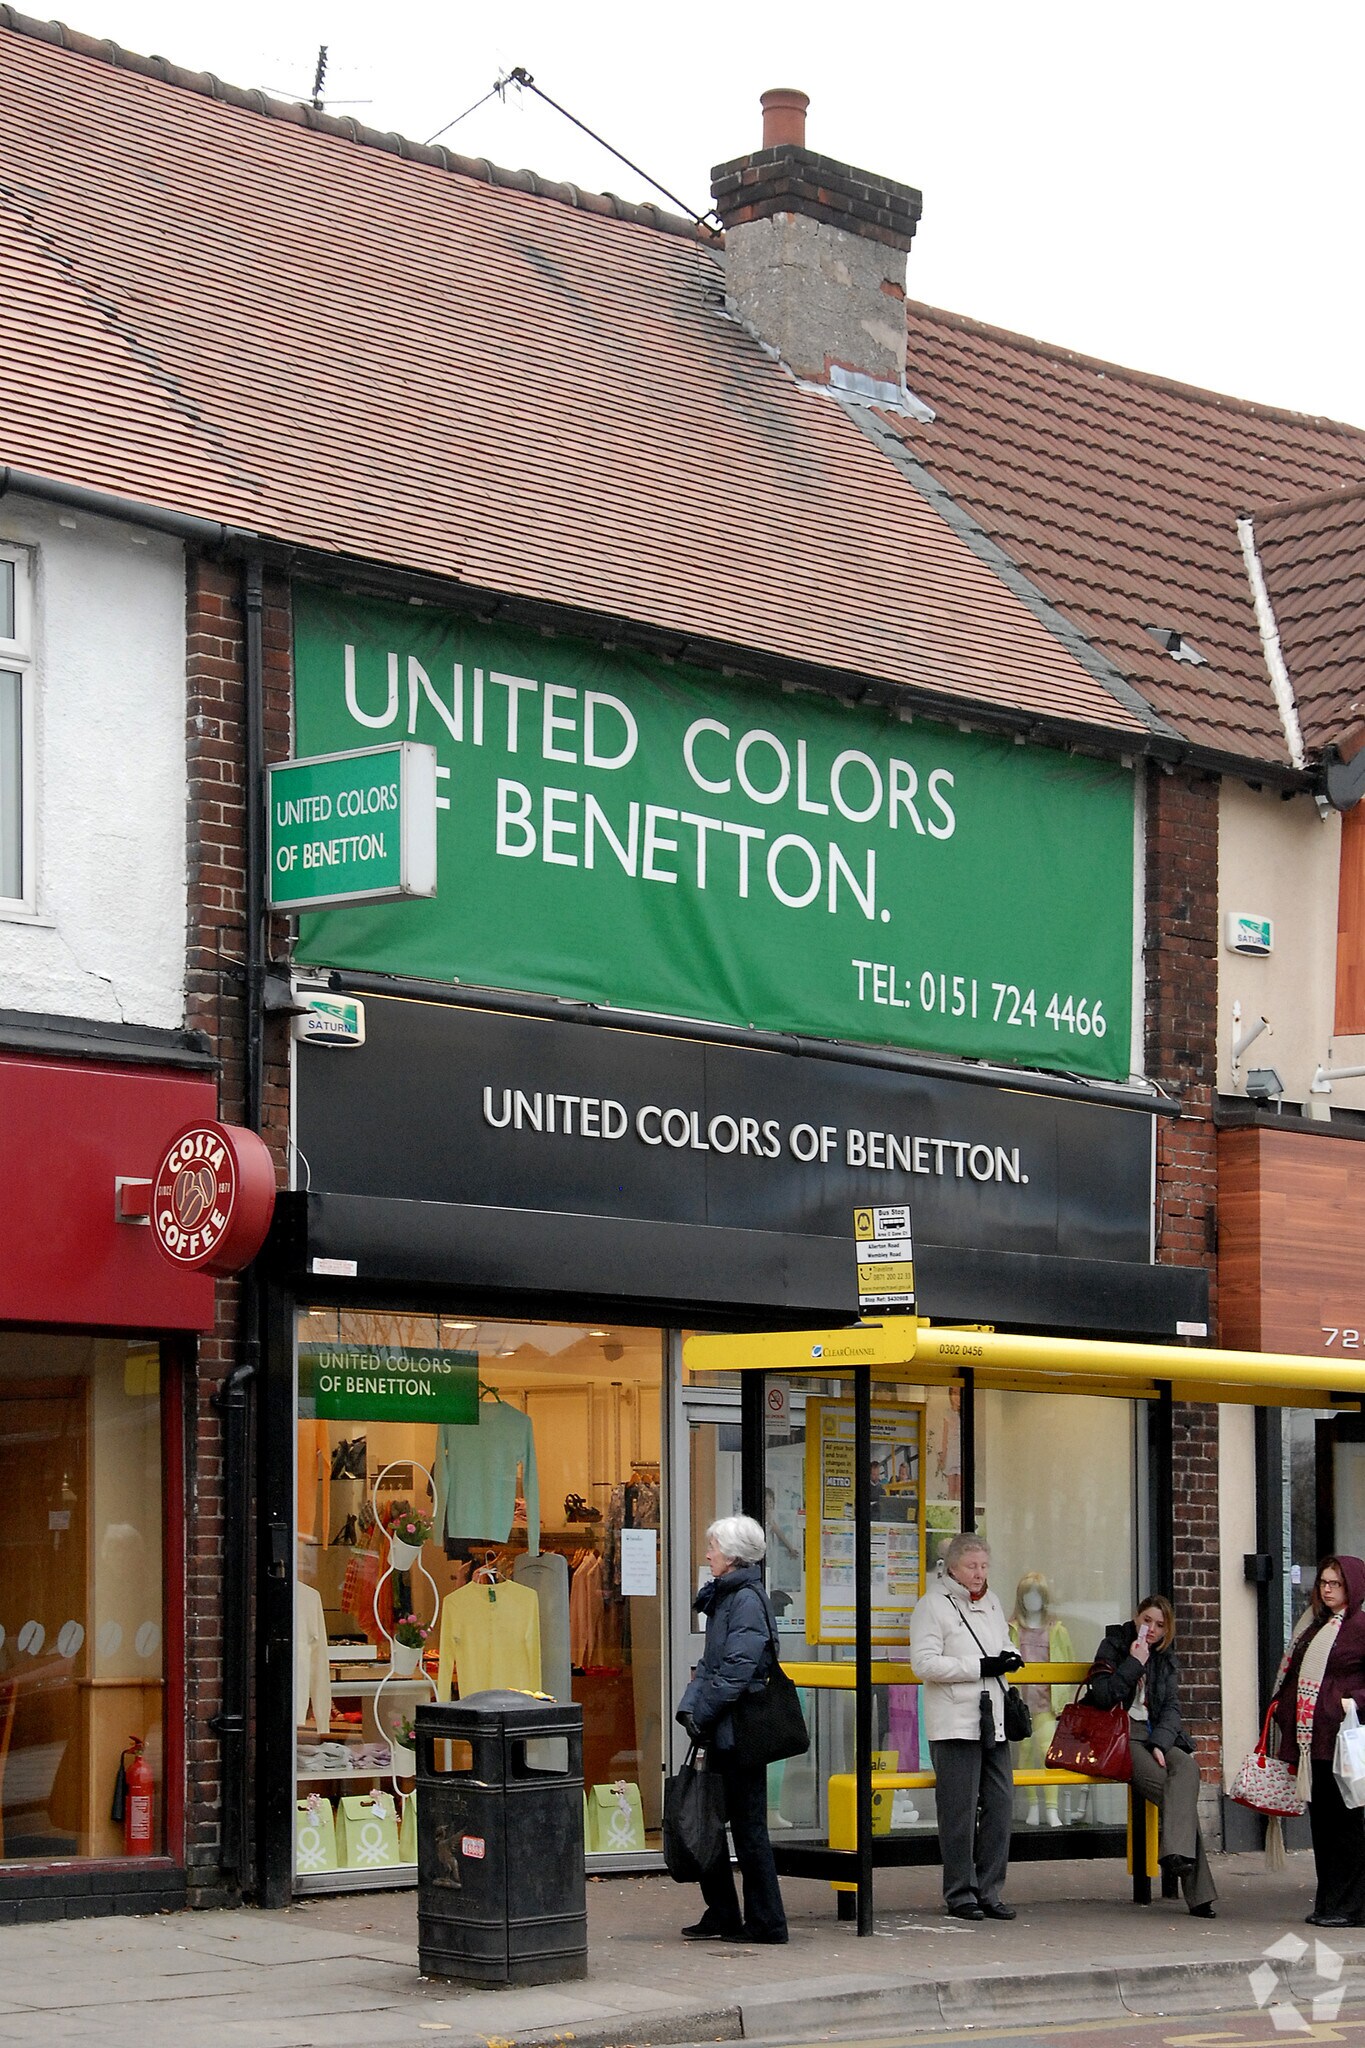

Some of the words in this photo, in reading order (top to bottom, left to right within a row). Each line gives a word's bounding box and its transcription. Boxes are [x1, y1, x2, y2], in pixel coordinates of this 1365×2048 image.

[344, 644, 639, 769] UNITED
[683, 718, 956, 840] COLORS
[277, 795, 332, 827] UNITED
[336, 783, 398, 818] COLORS
[276, 845, 298, 872] OF
[303, 832, 387, 869] BENETTON.
[496, 778, 891, 923] BENETTON.
[852, 959, 911, 1008] TEL:
[920, 971, 977, 1018] 0151
[991, 982, 1037, 1028] 724
[1044, 992, 1107, 1038] 4466
[308, 1020, 351, 1033] SATURN
[168, 1134, 226, 1173] COSTA
[483, 1086, 628, 1140] UNITED
[636, 1105, 782, 1159] COLORS
[788, 1122, 838, 1164] OF
[846, 1128, 1029, 1185] BENETTON.
[159, 1208, 226, 1255] COFFEE
[940, 1344, 960, 1355] 0302
[962, 1345, 983, 1357] 0456
[1321, 1327, 1365, 1348] 72
[319, 1352, 380, 1371] UNITED
[386, 1355, 452, 1374] COLORS
[319, 1375, 341, 1392] OF
[346, 1376, 436, 1396] BENETTON.
[826, 1477, 851, 1487] METRO
[871, 1757, 887, 1770] ale
